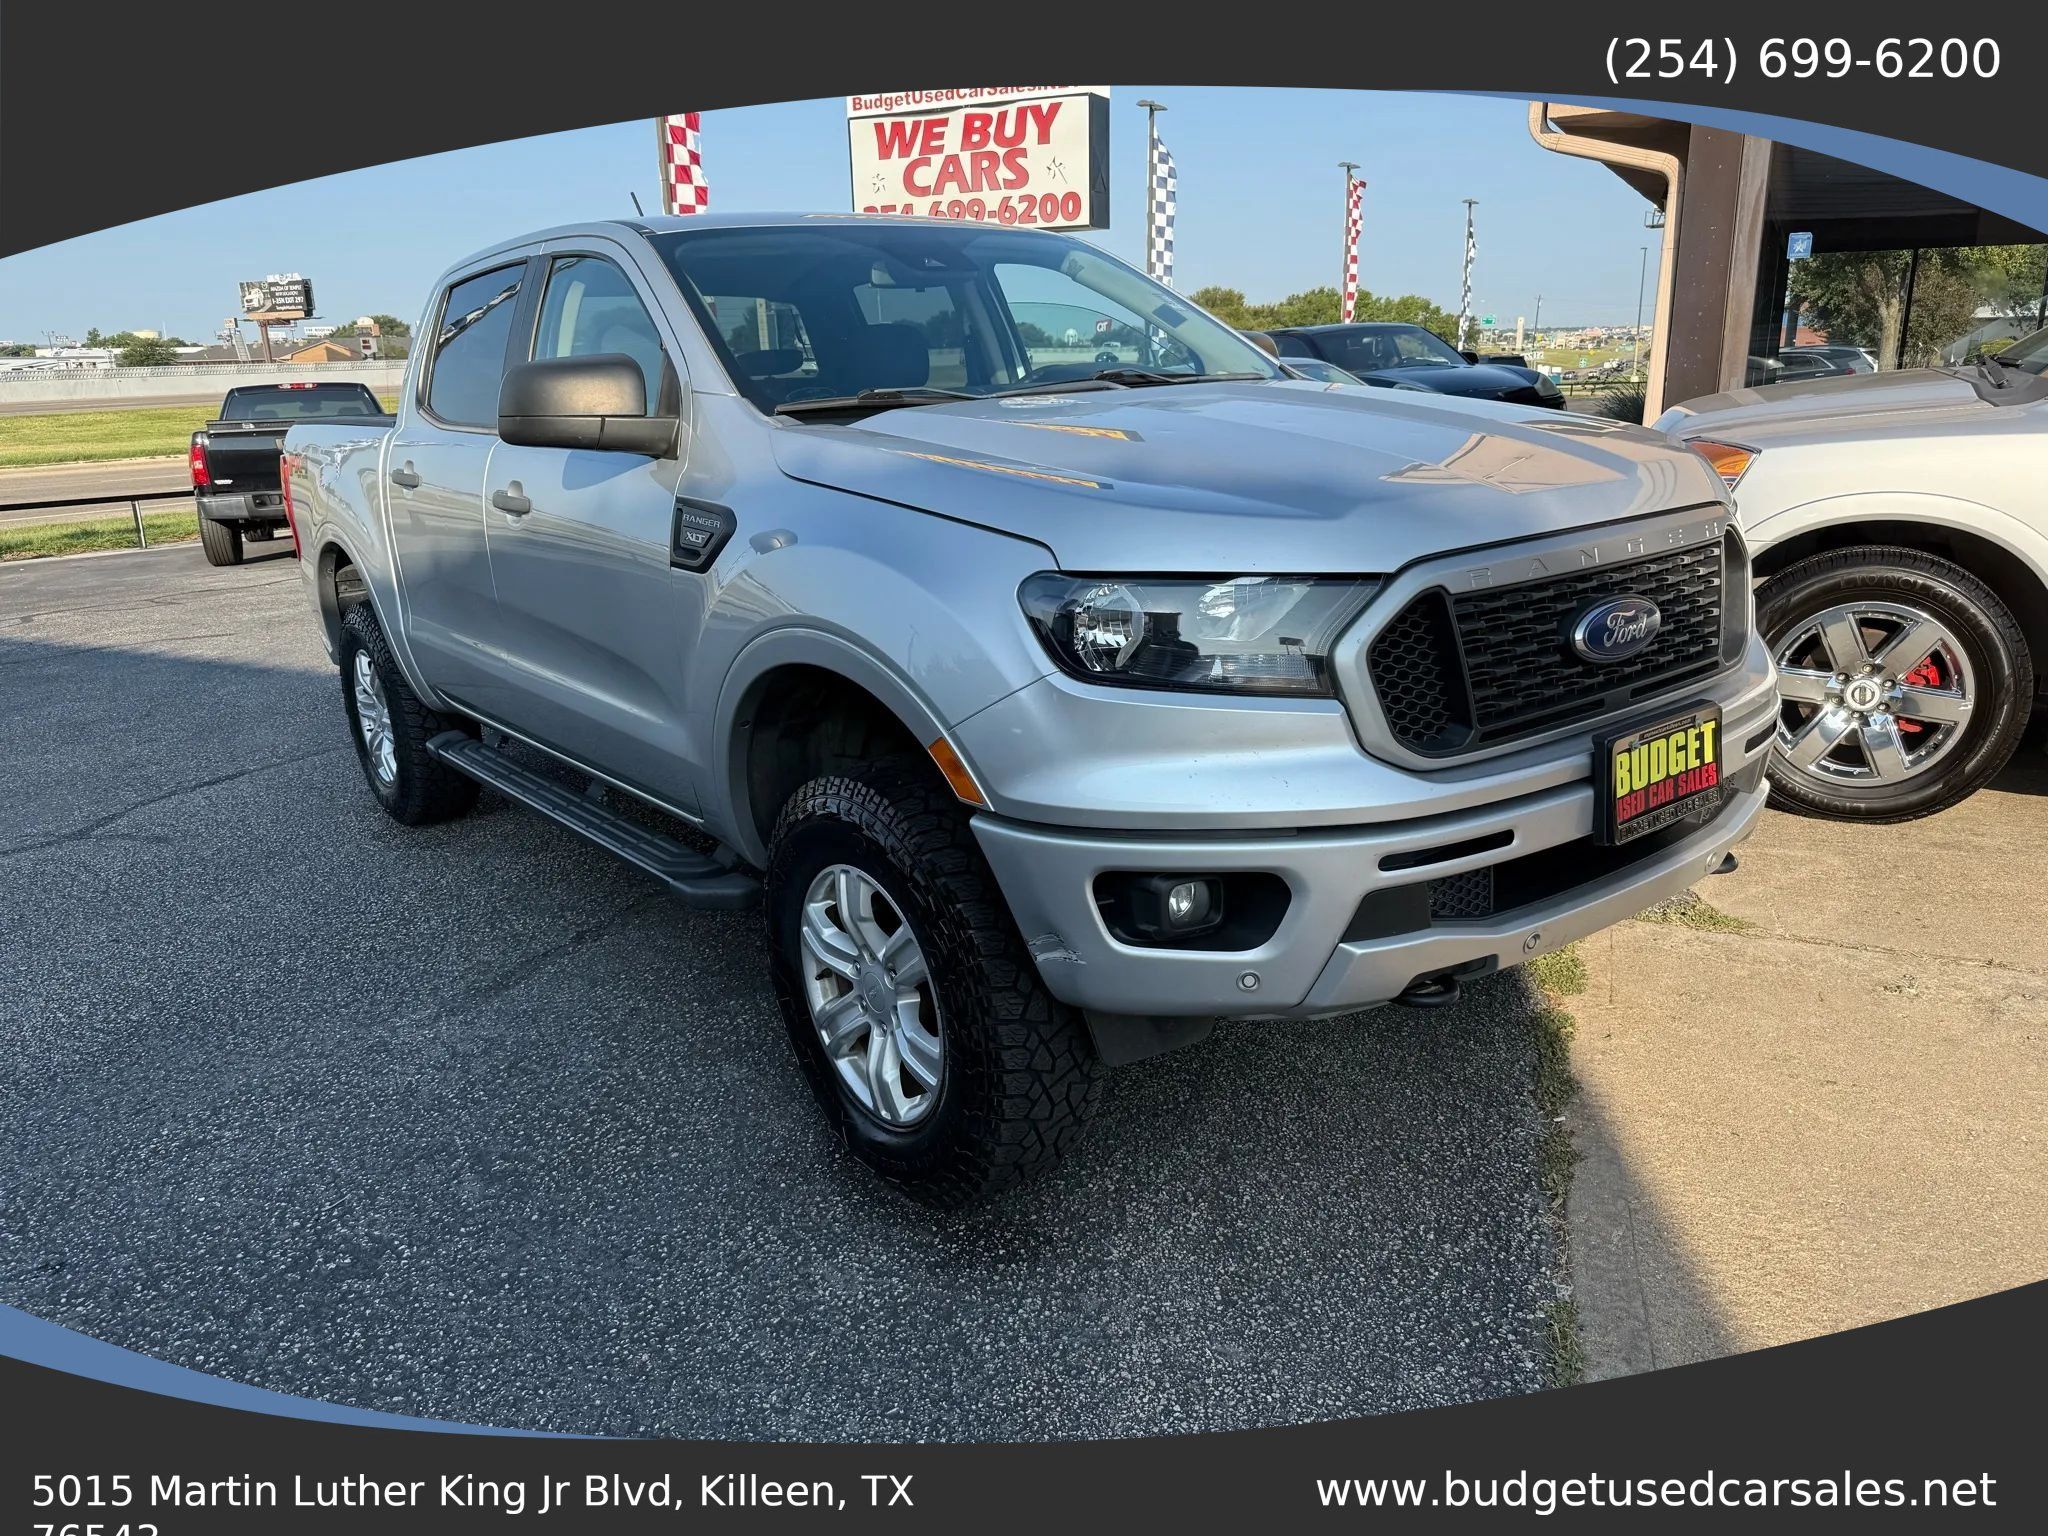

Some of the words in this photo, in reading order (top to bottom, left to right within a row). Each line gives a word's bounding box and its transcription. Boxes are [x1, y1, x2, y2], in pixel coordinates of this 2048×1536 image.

[874, 117, 949, 160] WE
[960, 102, 1063, 152] BUY
[902, 148, 1030, 197] CARS
[683, 513, 720, 529] RANGER
[685, 531, 705, 543] XLT
[1467, 521, 1720, 588] RANGER
[1603, 609, 1648, 648] Ford
[1616, 720, 1716, 799] BUDGET
[1648, 778, 1674, 805] CAR
[1678, 762, 1718, 797] SALES
